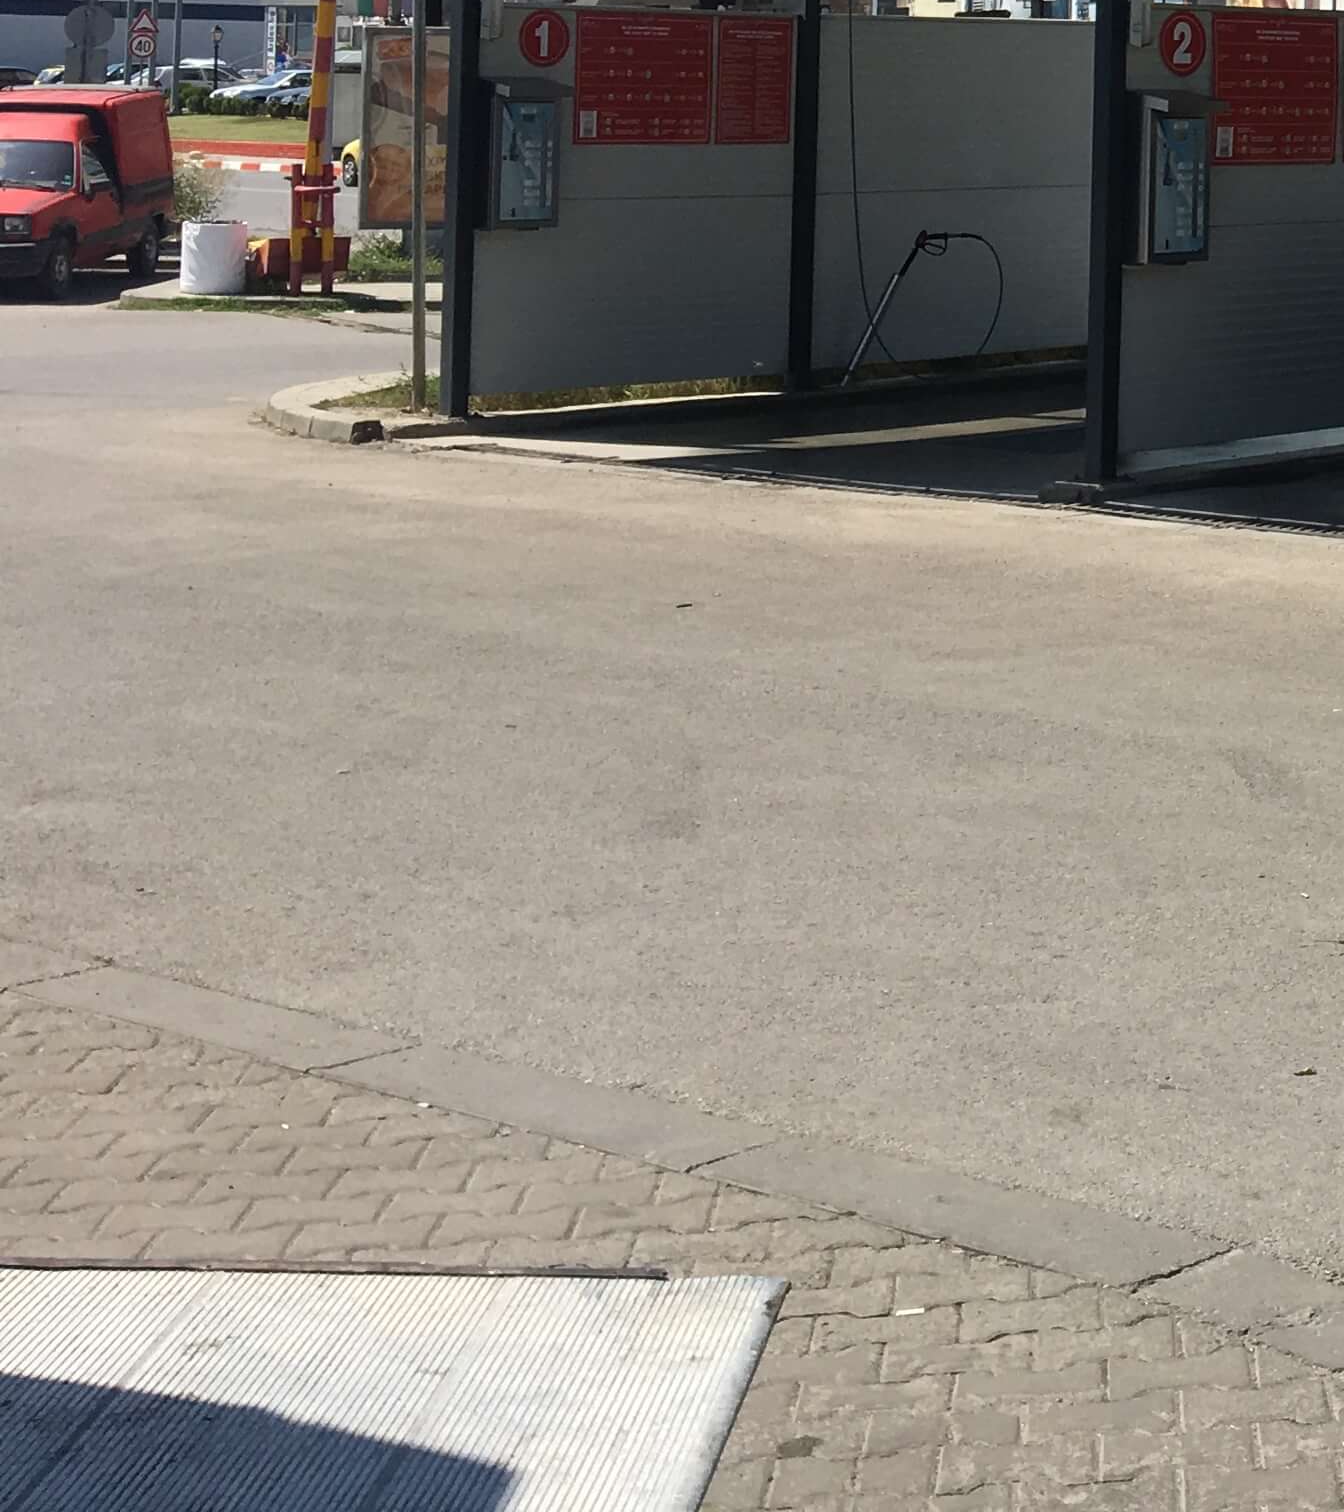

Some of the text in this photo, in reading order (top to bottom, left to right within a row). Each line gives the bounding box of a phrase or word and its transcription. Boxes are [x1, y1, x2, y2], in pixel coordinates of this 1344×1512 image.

[134, 38, 152, 54] 40
[535, 20, 548, 57] 1
[1172, 21, 1192, 65] 2
